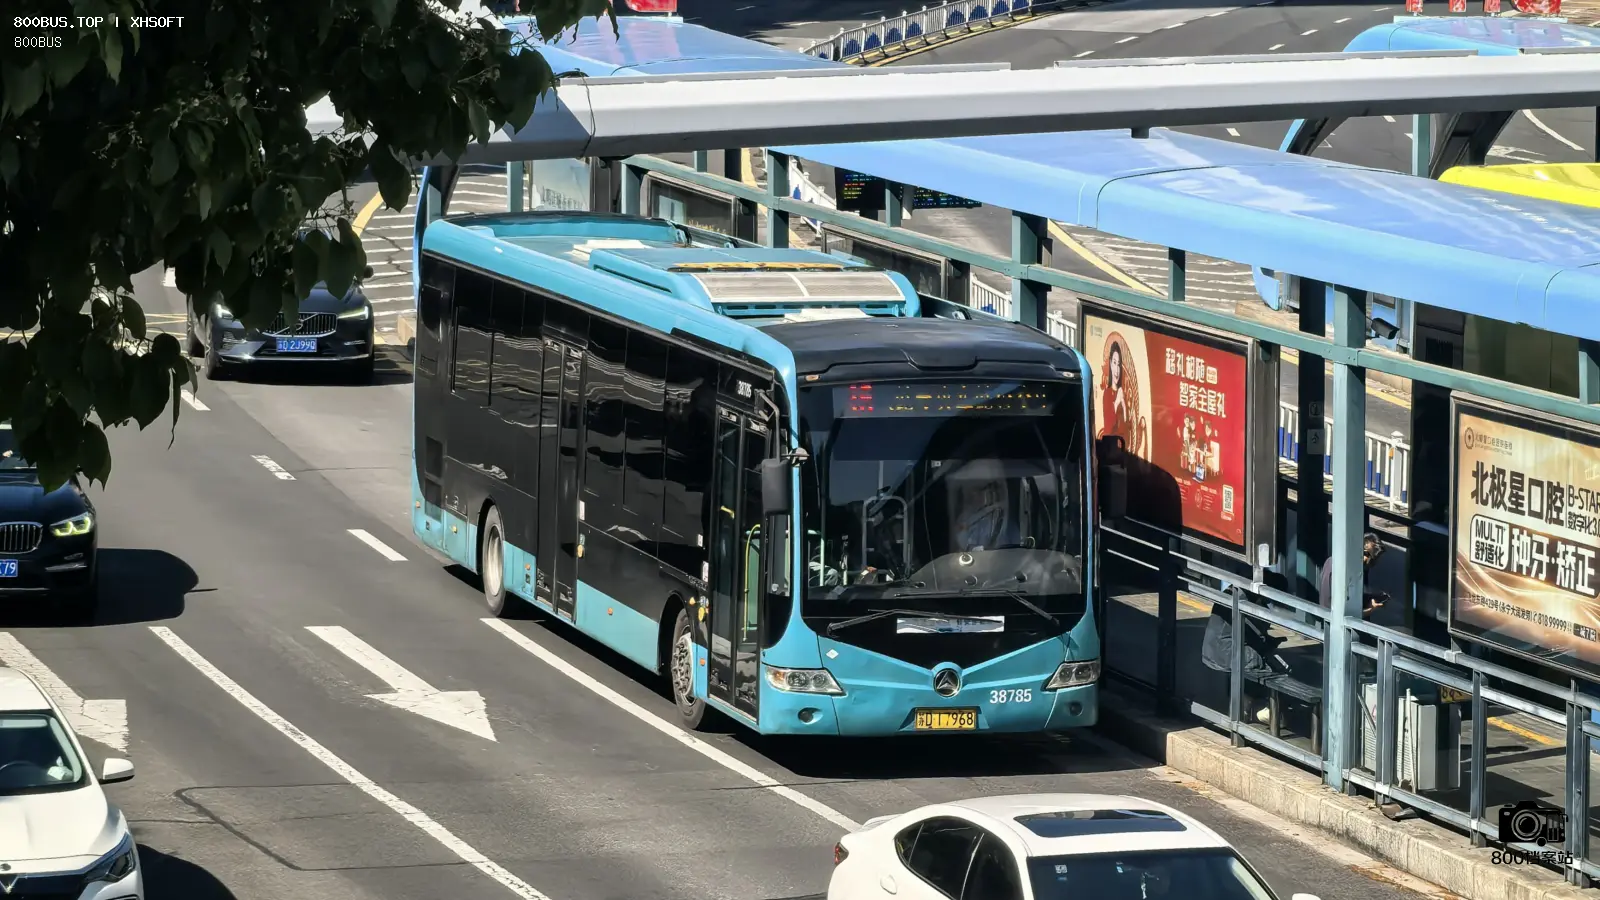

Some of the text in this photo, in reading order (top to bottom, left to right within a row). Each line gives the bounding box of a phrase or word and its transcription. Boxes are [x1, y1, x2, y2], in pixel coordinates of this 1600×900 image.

[1179, 381, 1227, 418] 智家全屋礼
[1471, 460, 1565, 526] 北极星口腔
[1475, 540, 1505, 567] 舒适化
[989, 688, 1032, 704] 38785
